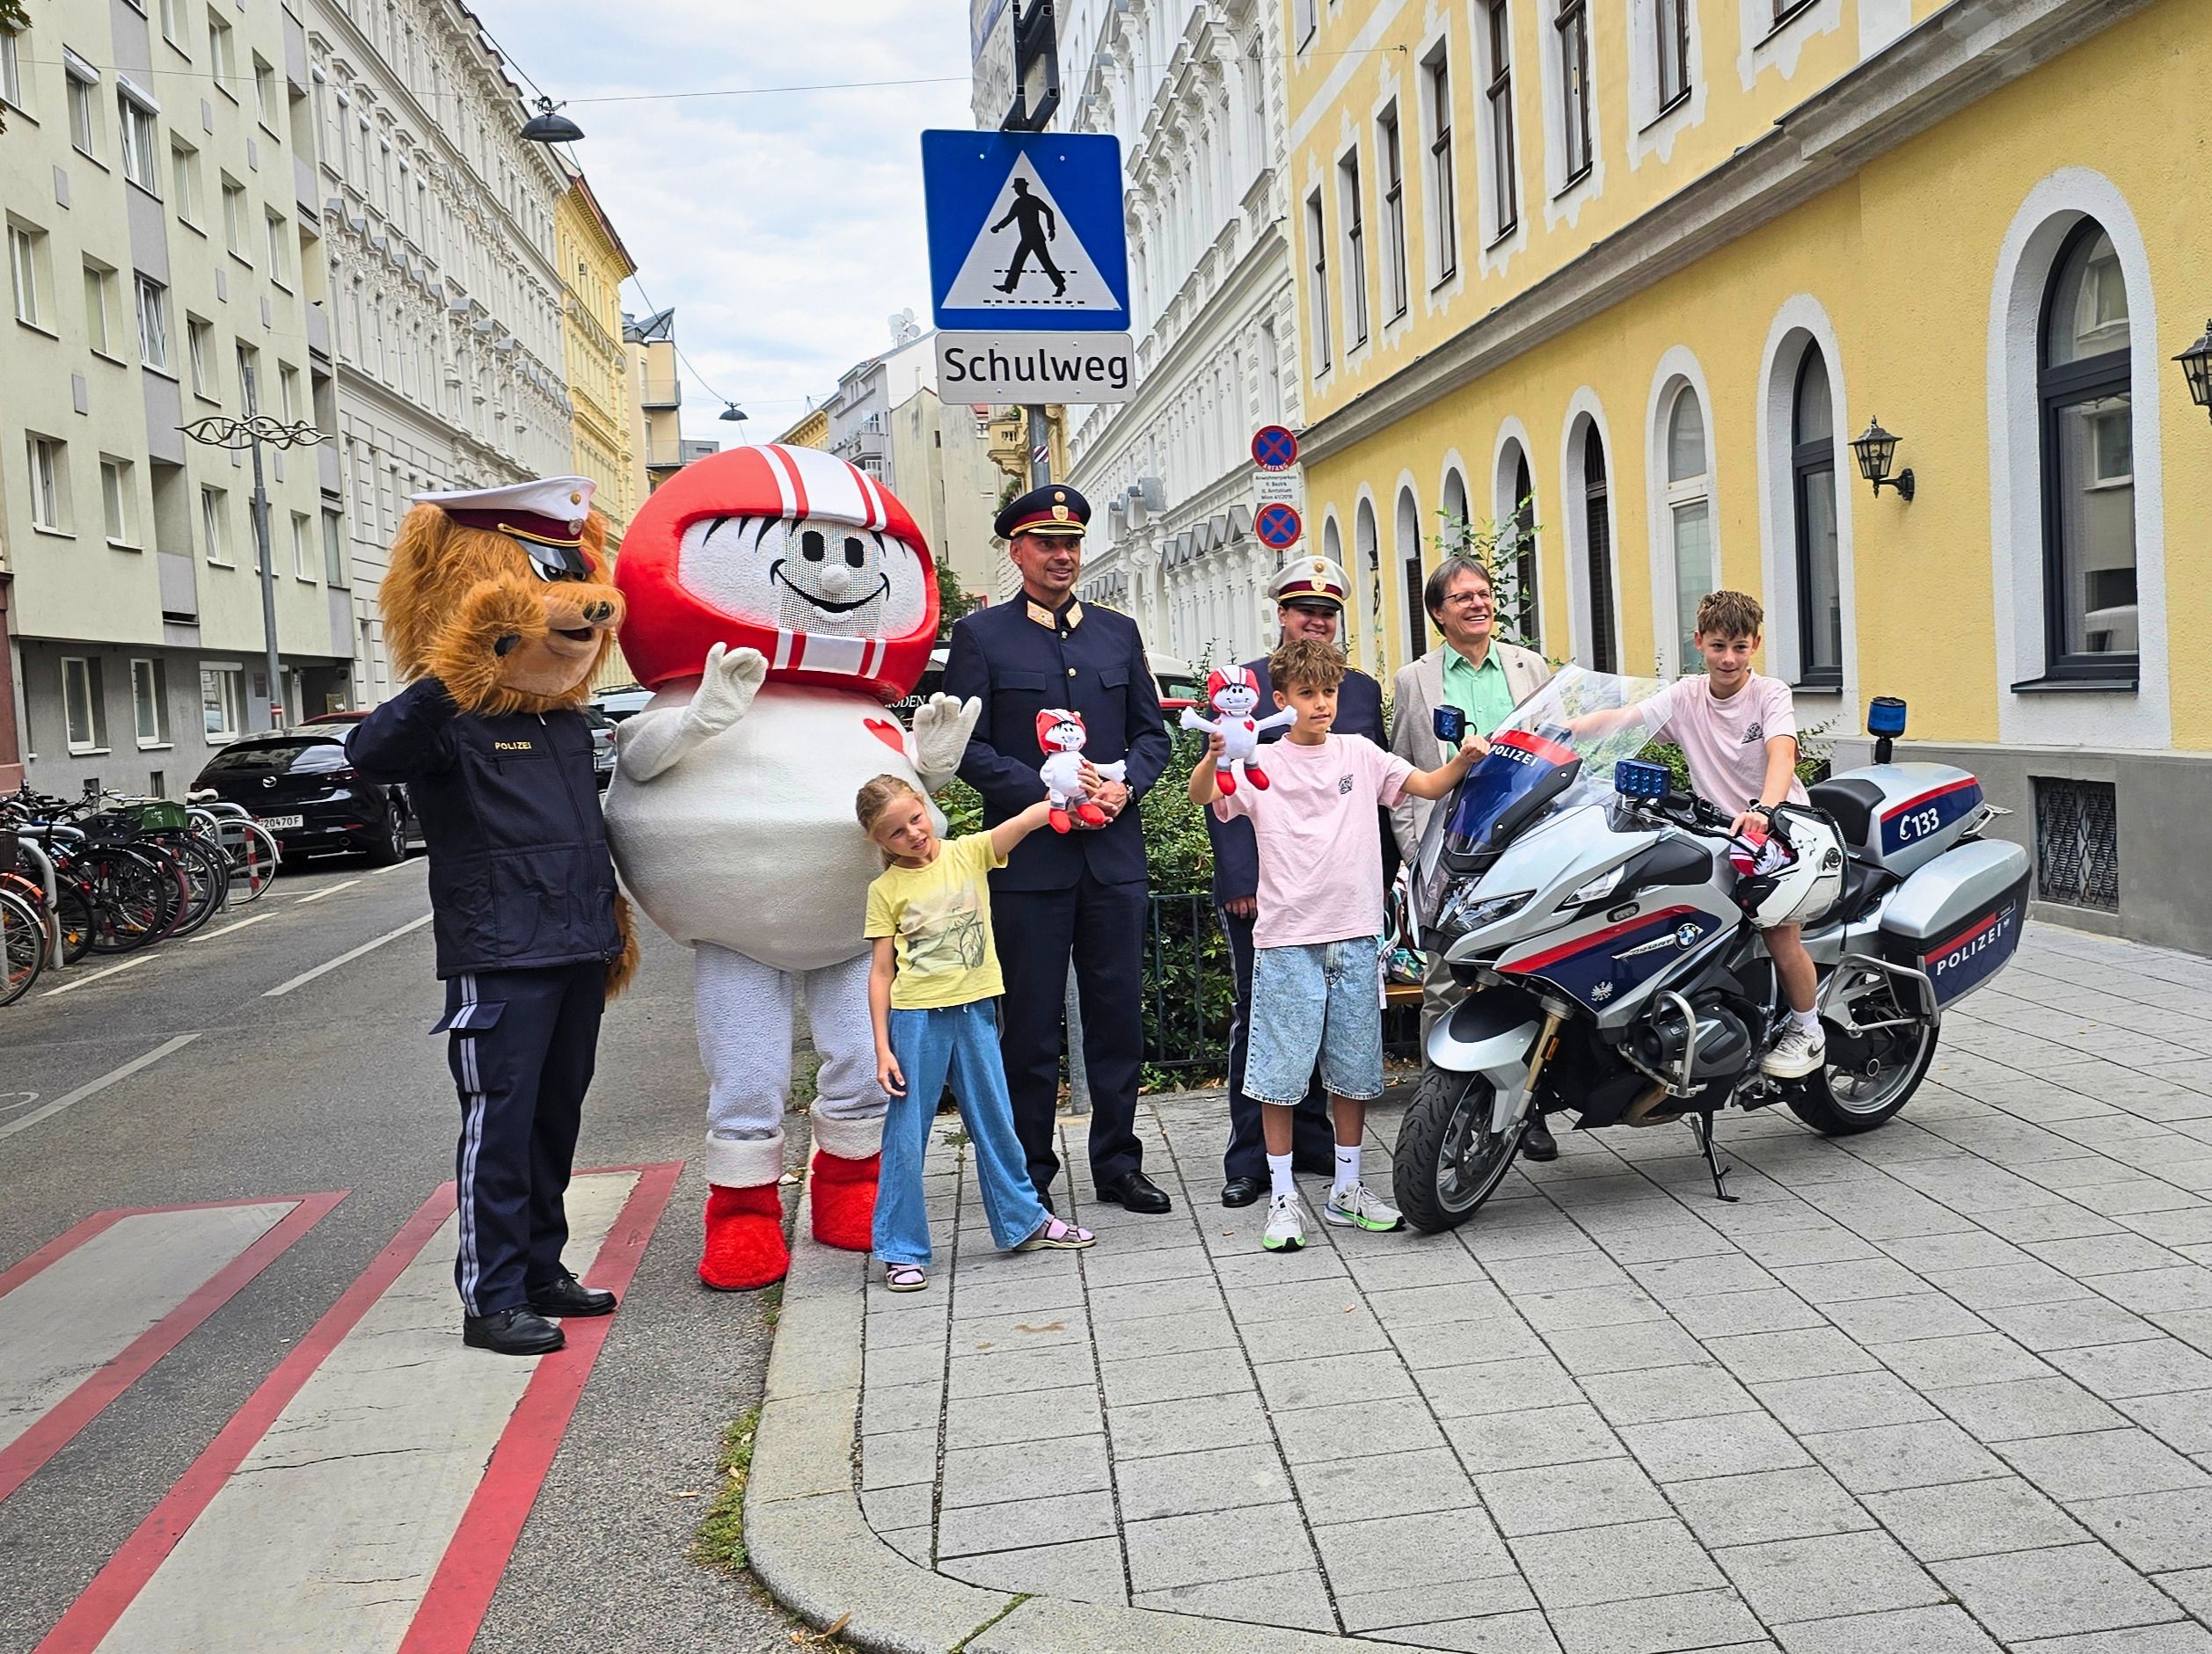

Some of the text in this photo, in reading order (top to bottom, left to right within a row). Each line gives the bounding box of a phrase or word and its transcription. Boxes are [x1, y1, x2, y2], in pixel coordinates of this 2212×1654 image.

[945, 347, 1128, 389] Schulweg
[1263, 463, 1289, 471] ANFANG
[885, 695, 927, 708] ODEN
[494, 741, 532, 750] POLIZEI
[1488, 744, 1539, 767] POLIZEI
[1911, 807, 1939, 836] 133
[1937, 922, 2001, 975] POLIZEI
